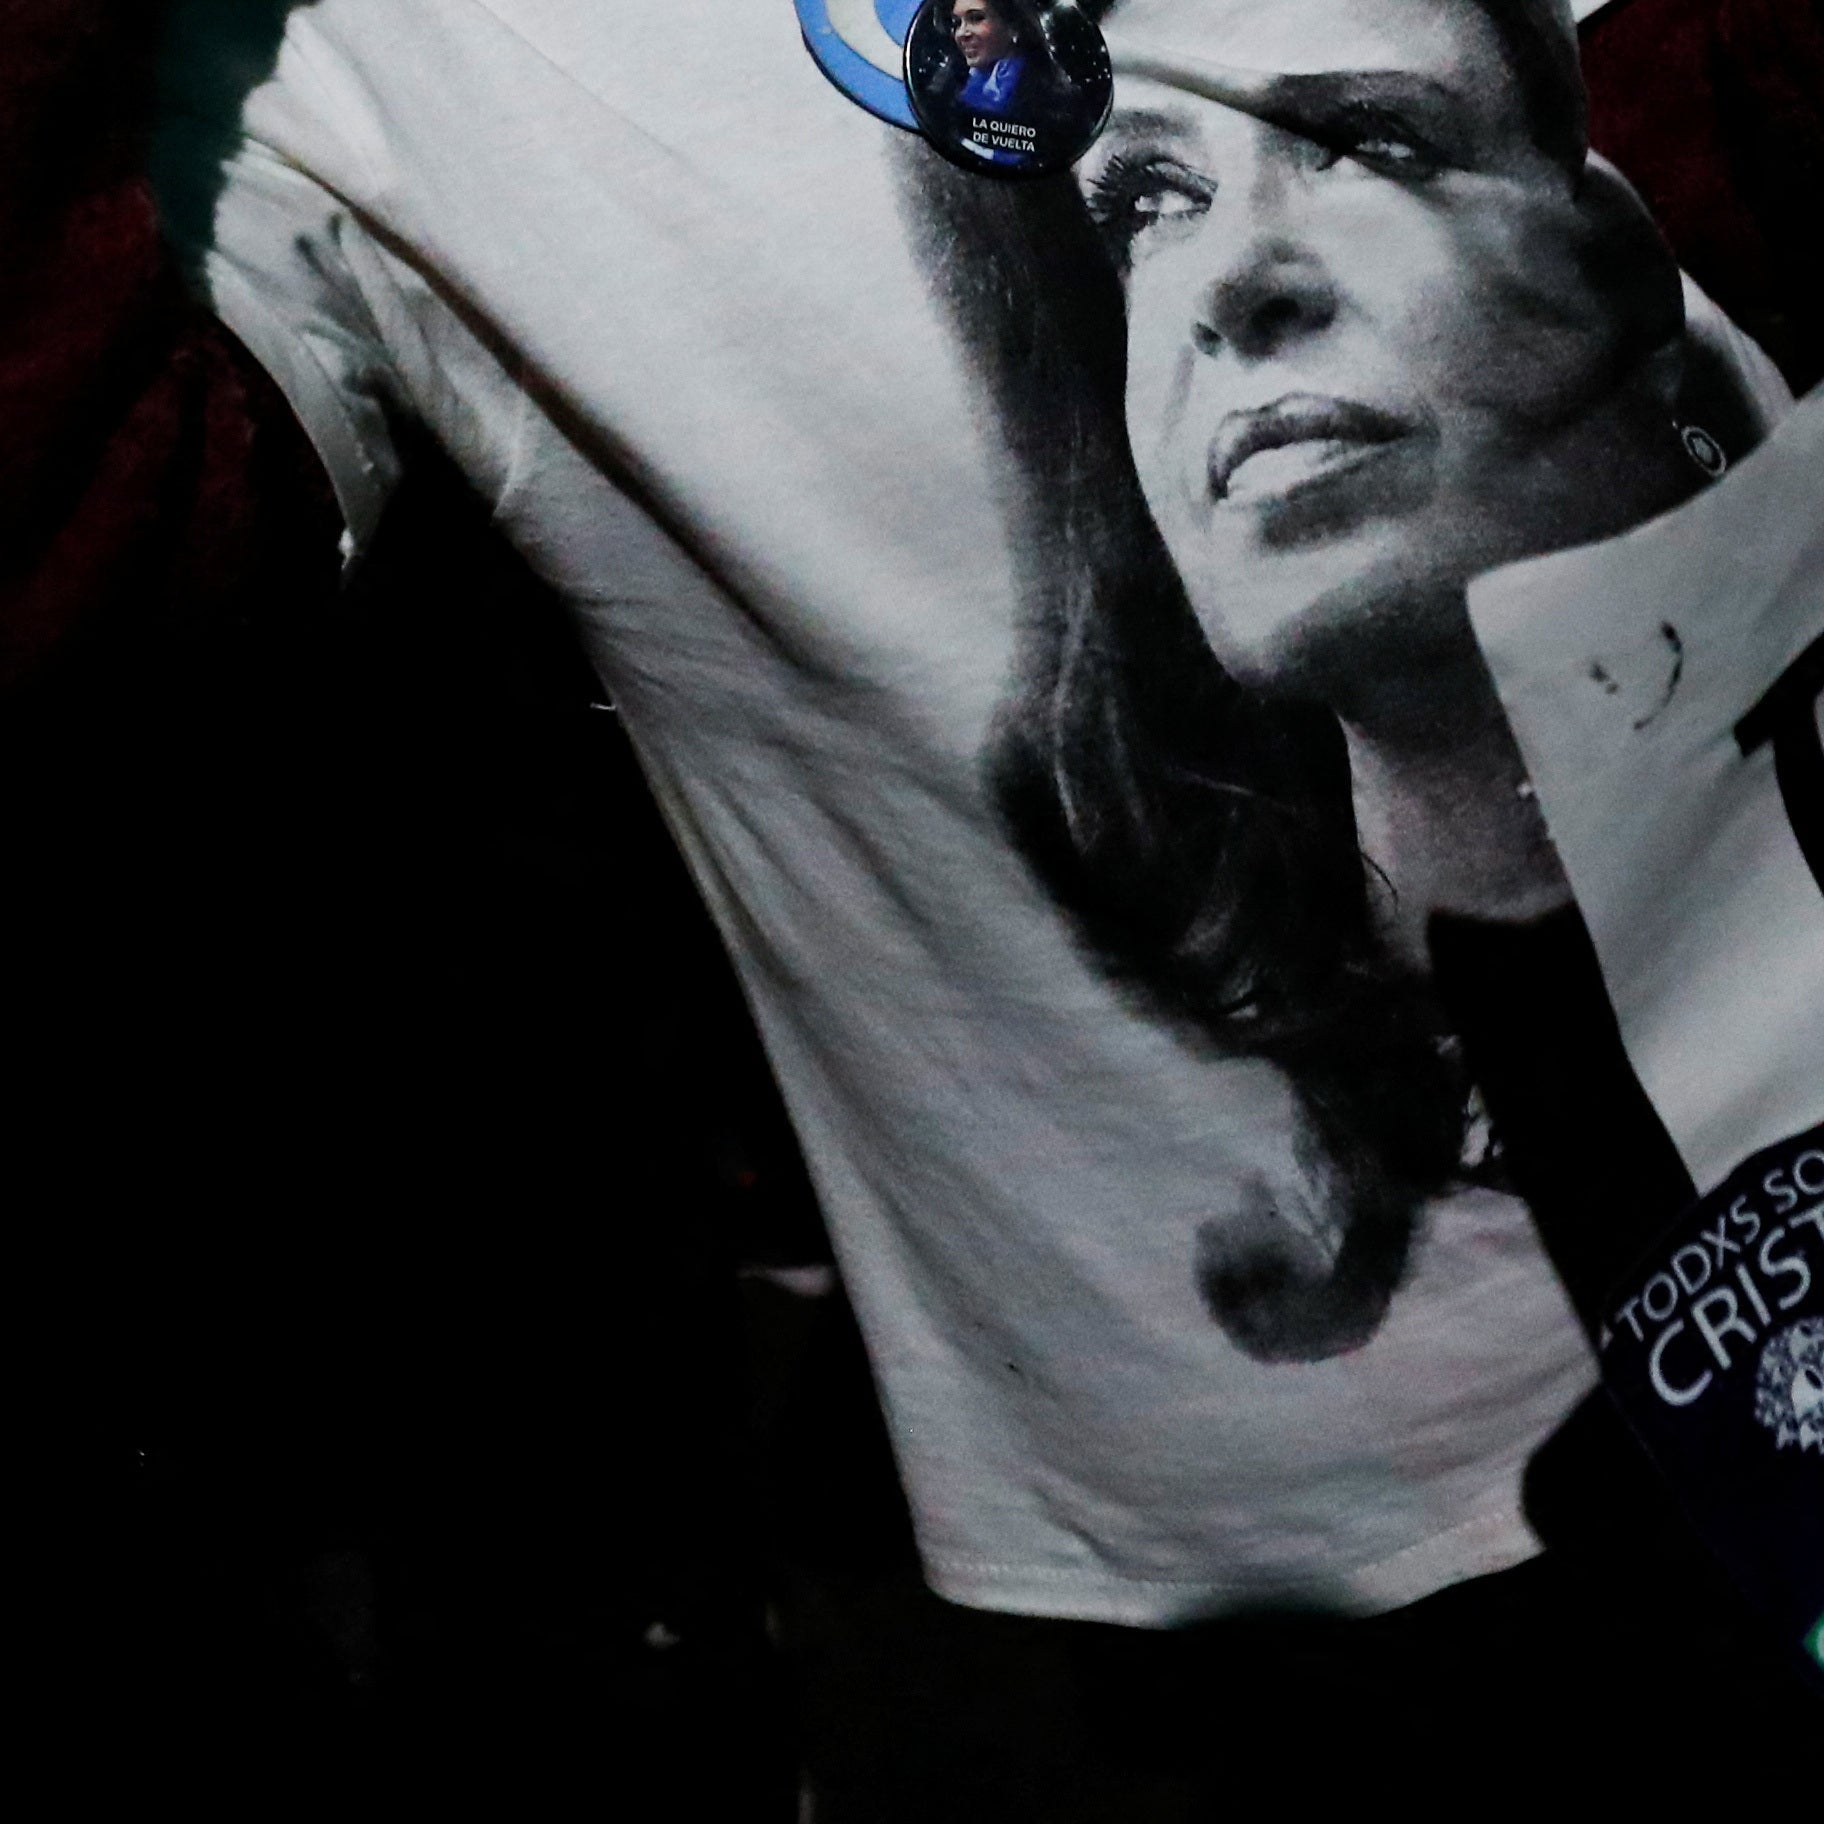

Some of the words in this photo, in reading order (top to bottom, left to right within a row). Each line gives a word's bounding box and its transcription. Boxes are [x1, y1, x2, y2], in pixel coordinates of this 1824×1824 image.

[972, 116, 988, 130] LA
[989, 120, 1037, 138] QUIERO
[972, 130, 989, 145] DE
[991, 134, 1036, 153] VUELTA
[1612, 1194, 1762, 1344] TODXS
